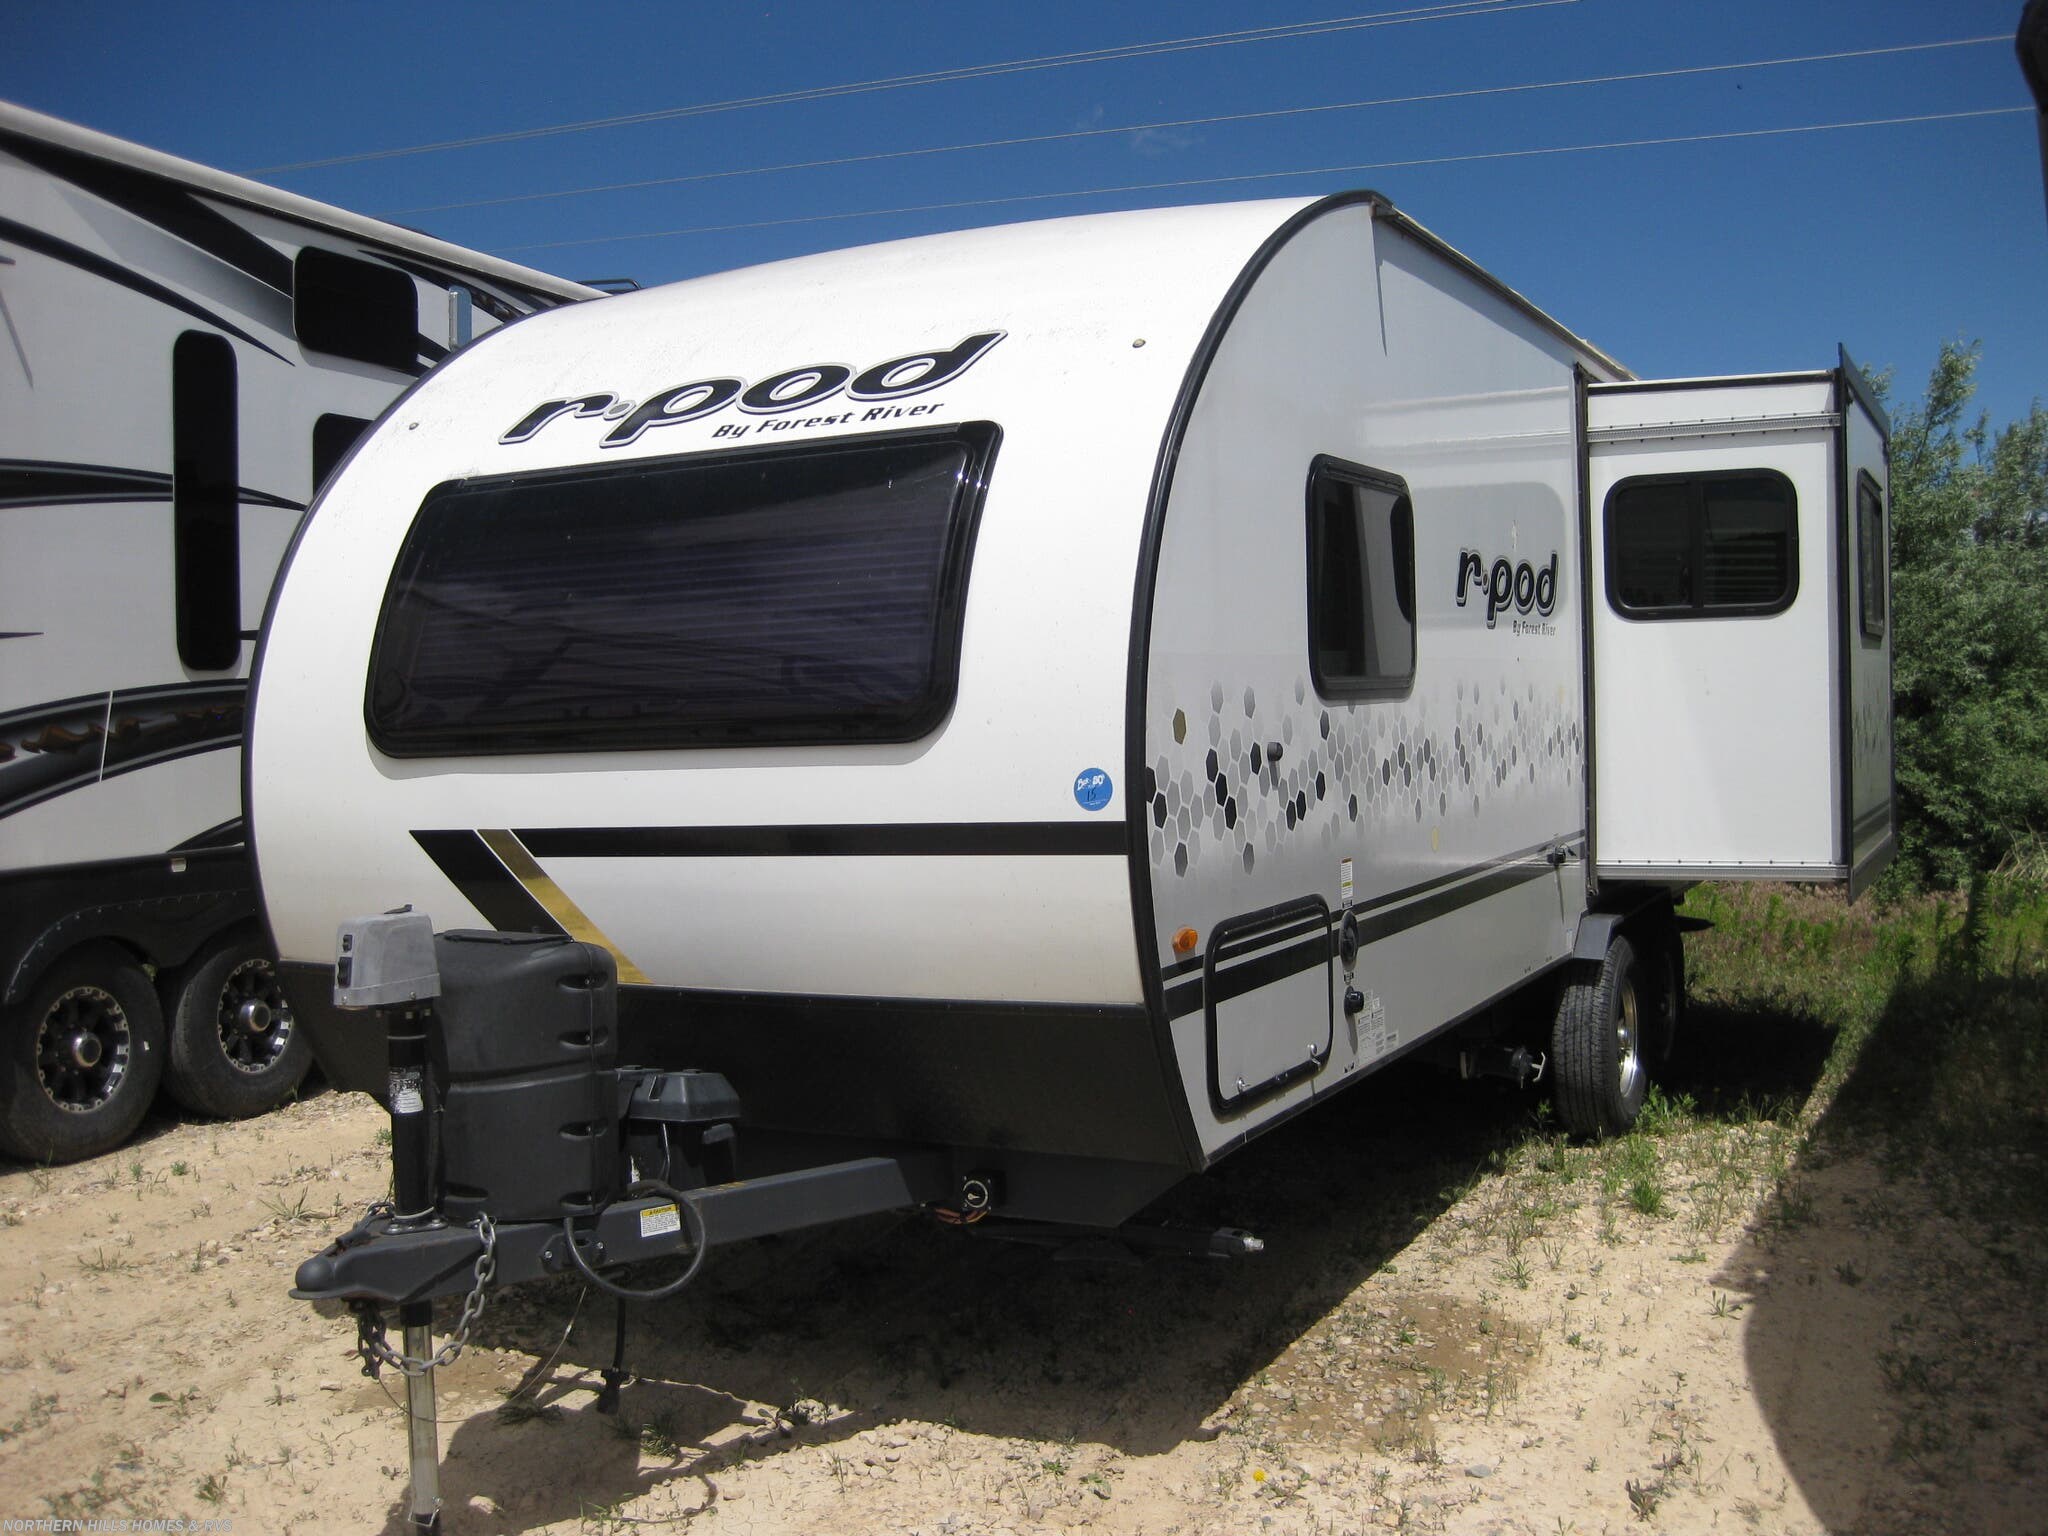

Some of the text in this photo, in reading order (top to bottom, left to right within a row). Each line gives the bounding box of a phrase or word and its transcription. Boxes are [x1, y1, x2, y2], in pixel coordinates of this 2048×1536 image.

[711, 402, 945, 440] By Forest River
[1512, 620, 1557, 637] By Forest River
